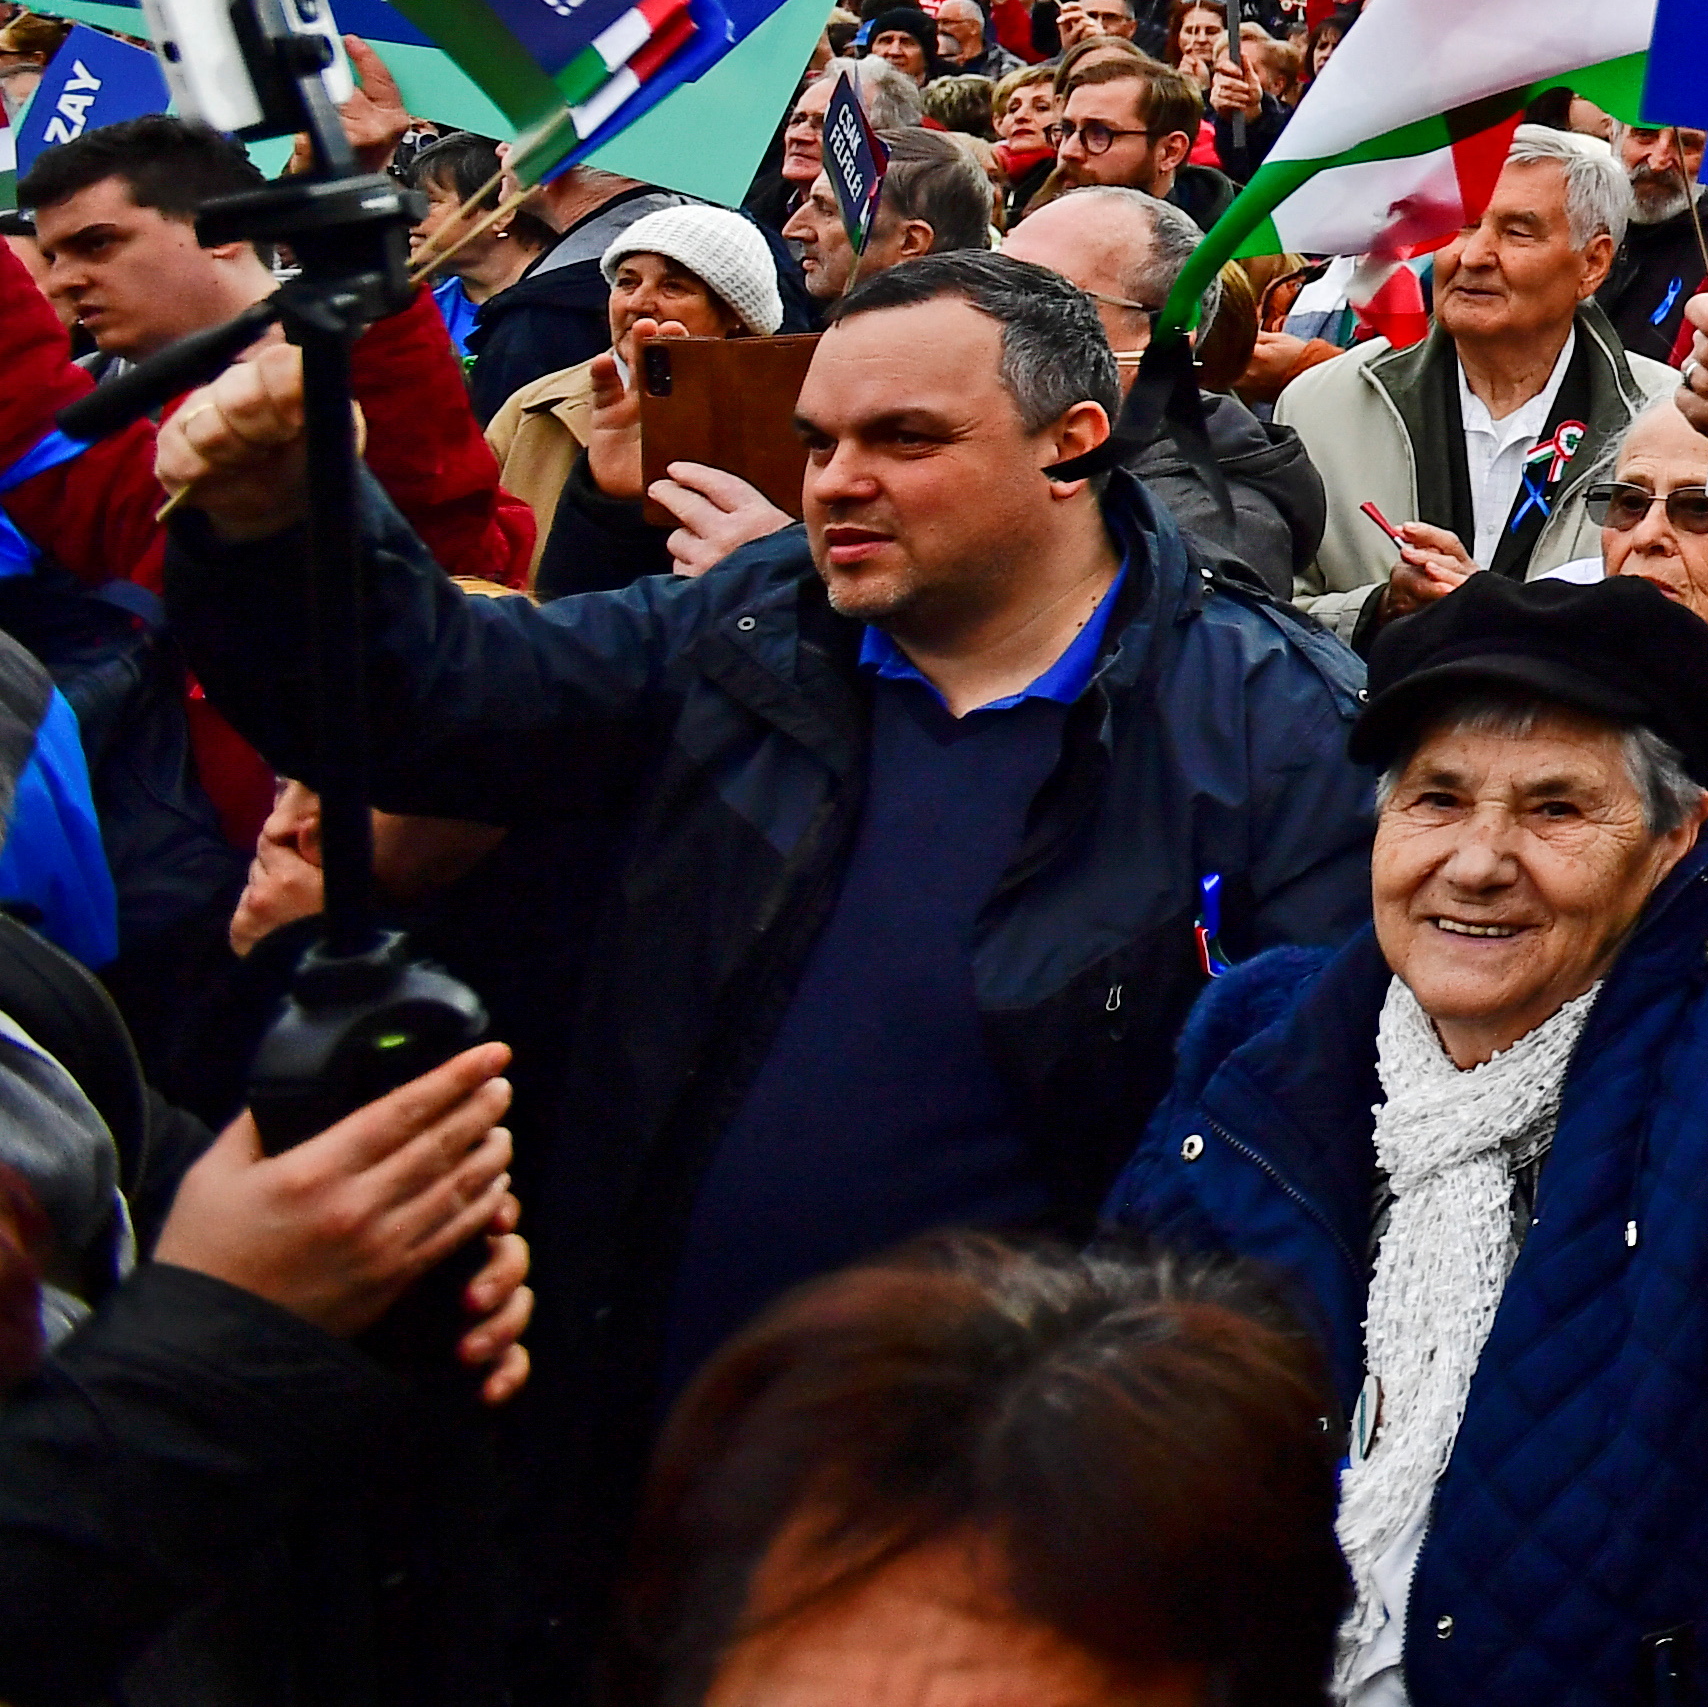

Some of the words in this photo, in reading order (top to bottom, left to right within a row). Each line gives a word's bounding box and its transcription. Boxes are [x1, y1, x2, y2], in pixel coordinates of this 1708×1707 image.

[43, 58, 102, 145] ZAY
[839, 103, 862, 158] CSAK
[829, 123, 863, 204] FELFELÉ!
